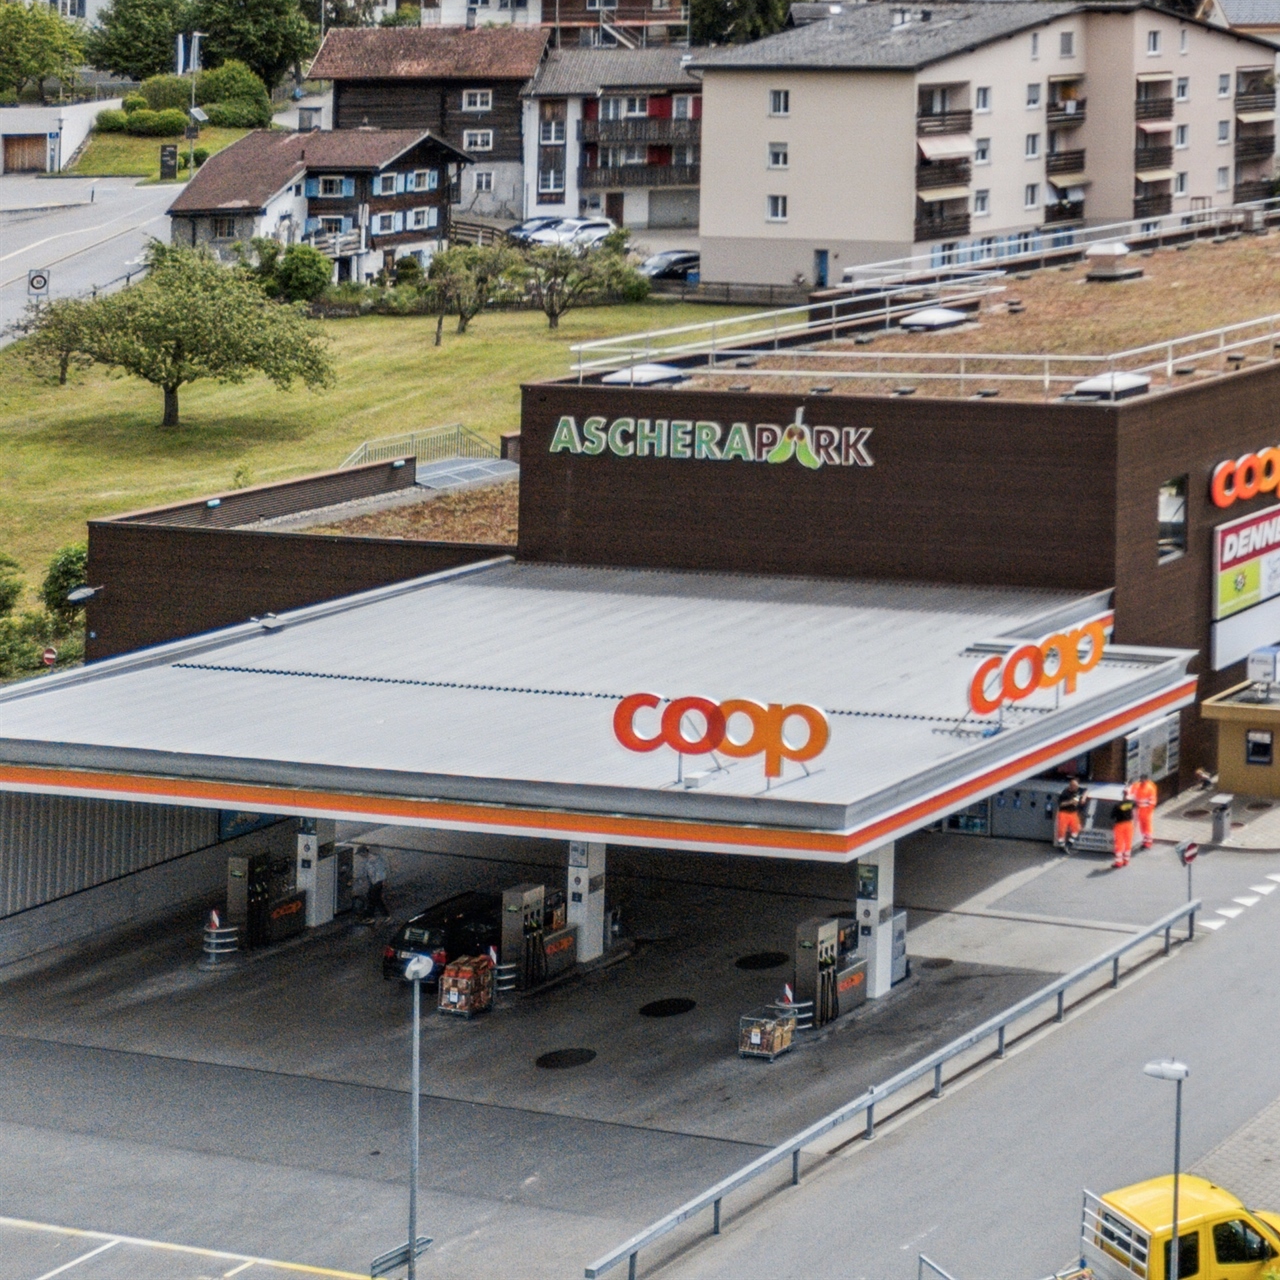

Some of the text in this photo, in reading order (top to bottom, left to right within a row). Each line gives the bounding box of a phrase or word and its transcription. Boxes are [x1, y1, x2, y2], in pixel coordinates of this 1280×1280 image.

[549, 406, 874, 469] ASCHERAPARK
[968, 622, 1104, 716] coop
[612, 692, 832, 778] coop
